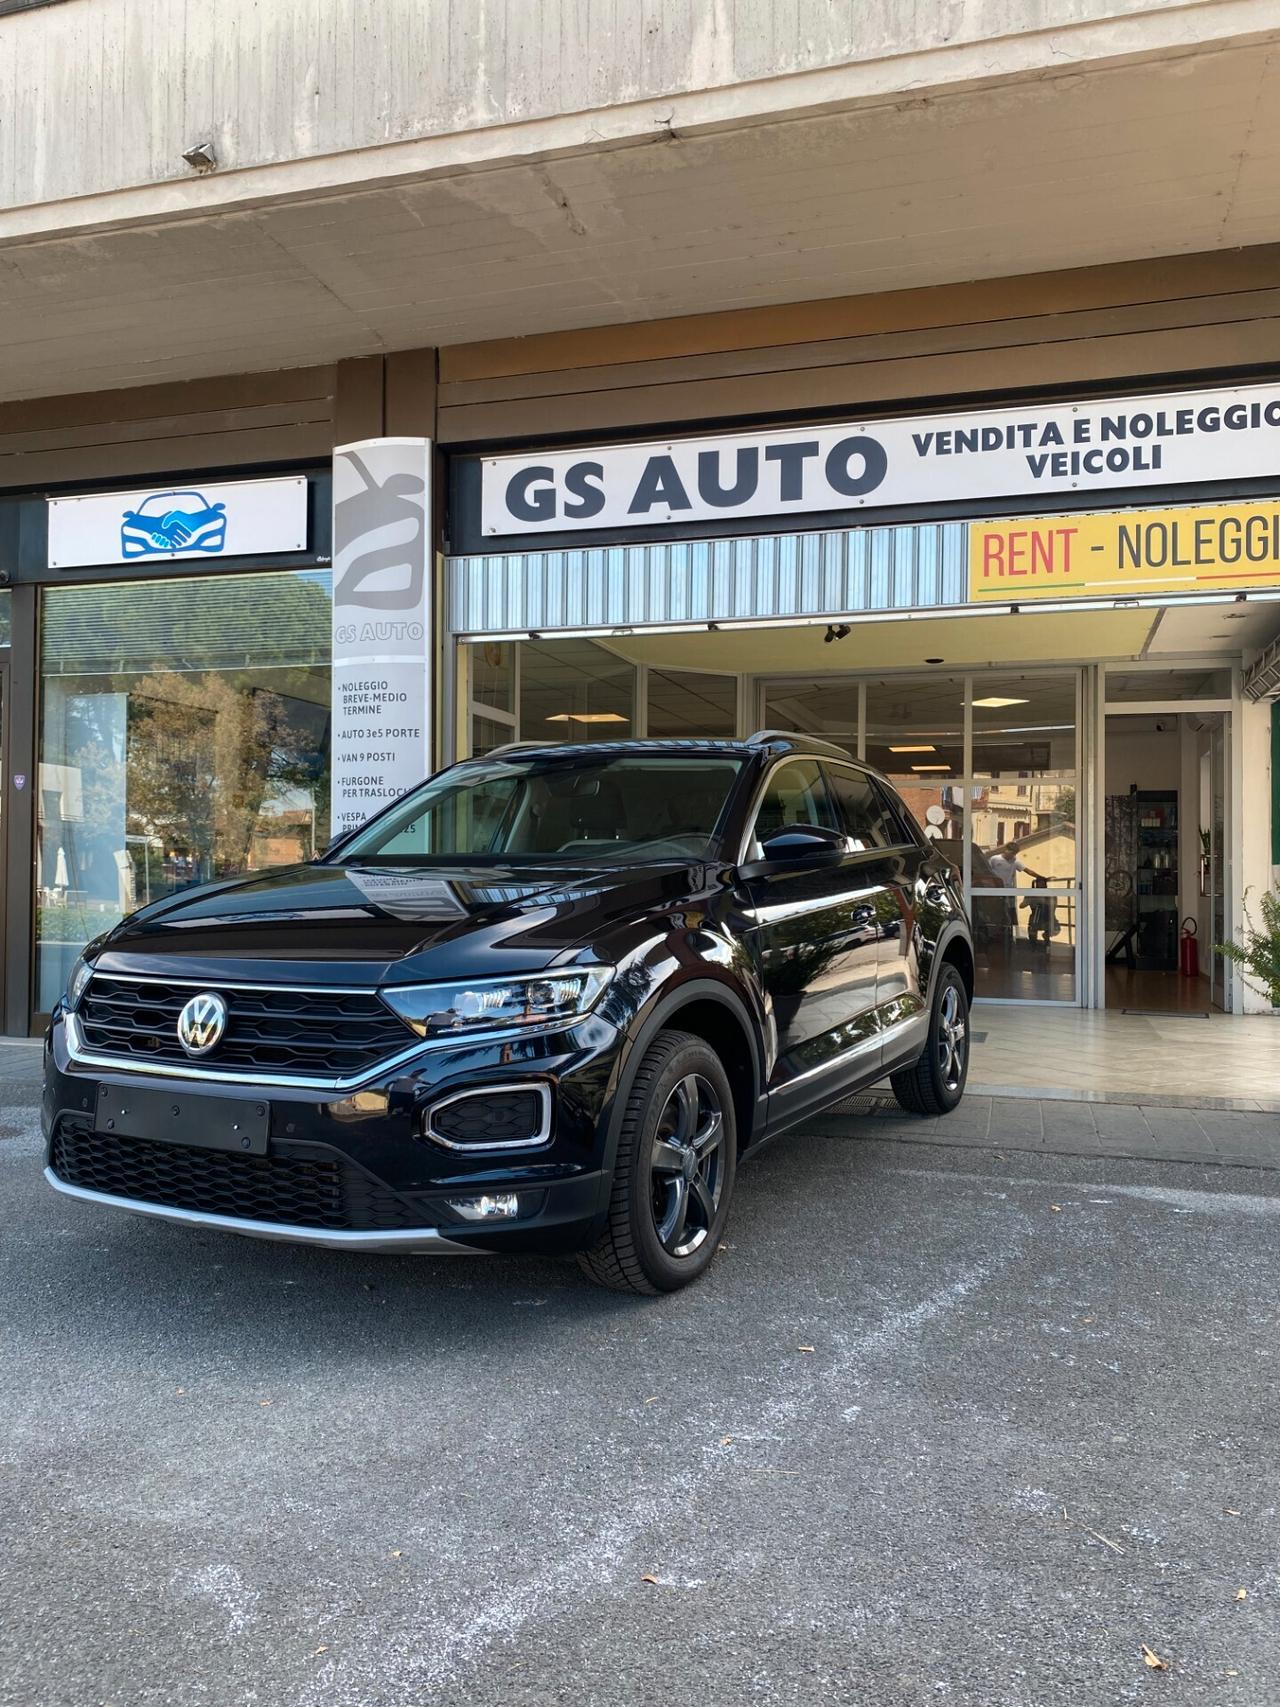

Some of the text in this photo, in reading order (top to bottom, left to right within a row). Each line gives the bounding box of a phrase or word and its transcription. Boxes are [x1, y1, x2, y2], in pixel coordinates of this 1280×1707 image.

[912, 400, 1280, 457] VENDITA E NOLEGGIO
[1026, 445, 1162, 479] VEICOLI
[505, 435, 888, 522] GS AUTO
[983, 528, 1078, 578] RENT
[1118, 514, 1279, 570] NOLEGGI
[335, 621, 424, 644] GS AUTO
[342, 681, 388, 692] NOLEGGIO
[343, 693, 407, 704] BREVE-MEDIO
[343, 705, 382, 716] TERMINE
[341, 729, 364, 739] AUTO
[386, 728, 420, 738] PORTE
[342, 752, 396, 762] VAN 9 POSTI
[342, 776, 384, 786] FURGONE
[342, 788, 357, 798] PER
[342, 812, 366, 821] VESPA
